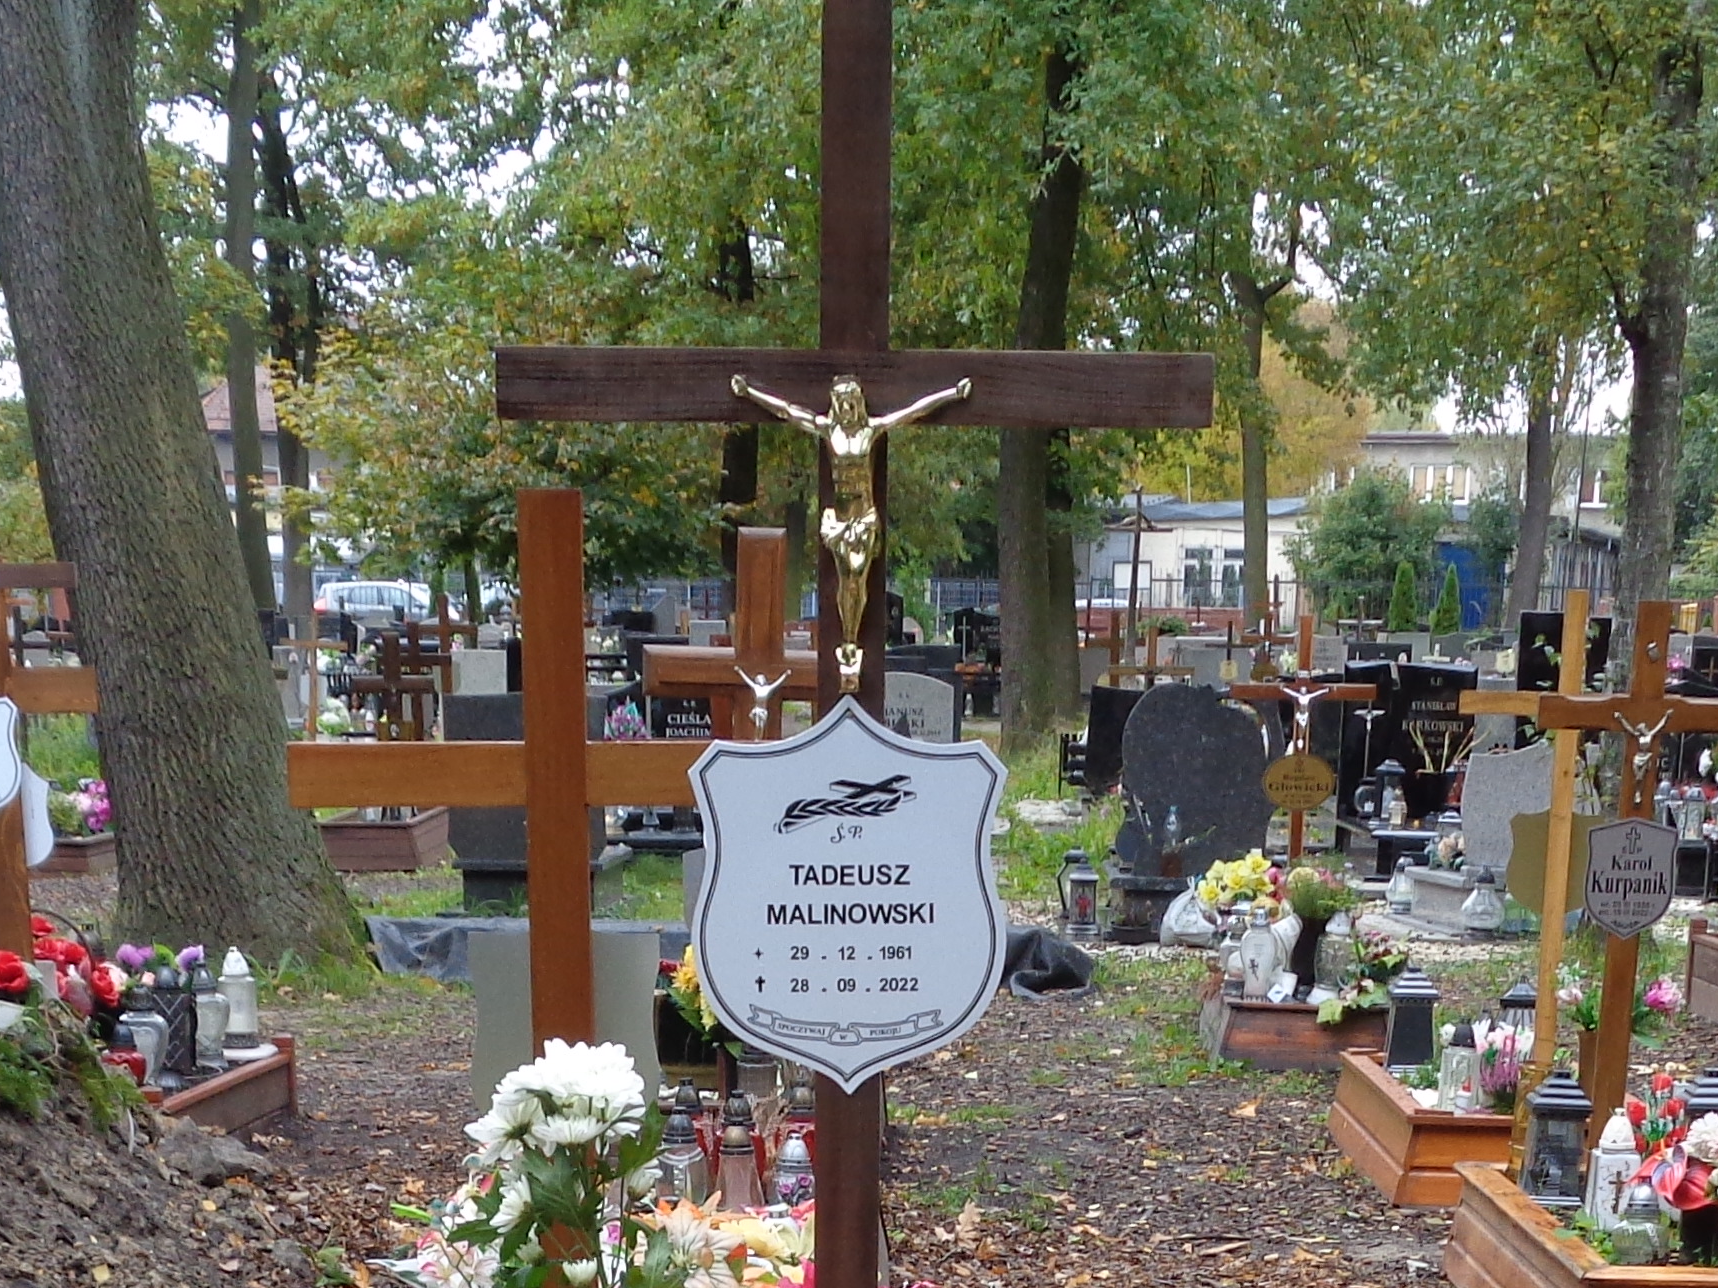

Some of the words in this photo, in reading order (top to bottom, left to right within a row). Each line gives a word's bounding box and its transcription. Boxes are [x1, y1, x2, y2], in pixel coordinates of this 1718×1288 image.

[1611, 854, 1652, 871] Karol
[789, 864, 911, 886] TADEUSZ
[1590, 870, 1668, 901] Kurpanik
[766, 901, 935, 926] MALINOWSKI
[790, 946, 810, 961] 29
[838, 946, 856, 961] 12
[879, 945, 913, 960] 1961
[790, 978, 810, 993] 28
[837, 978, 856, 993] 09
[879, 977, 919, 992] 2022
